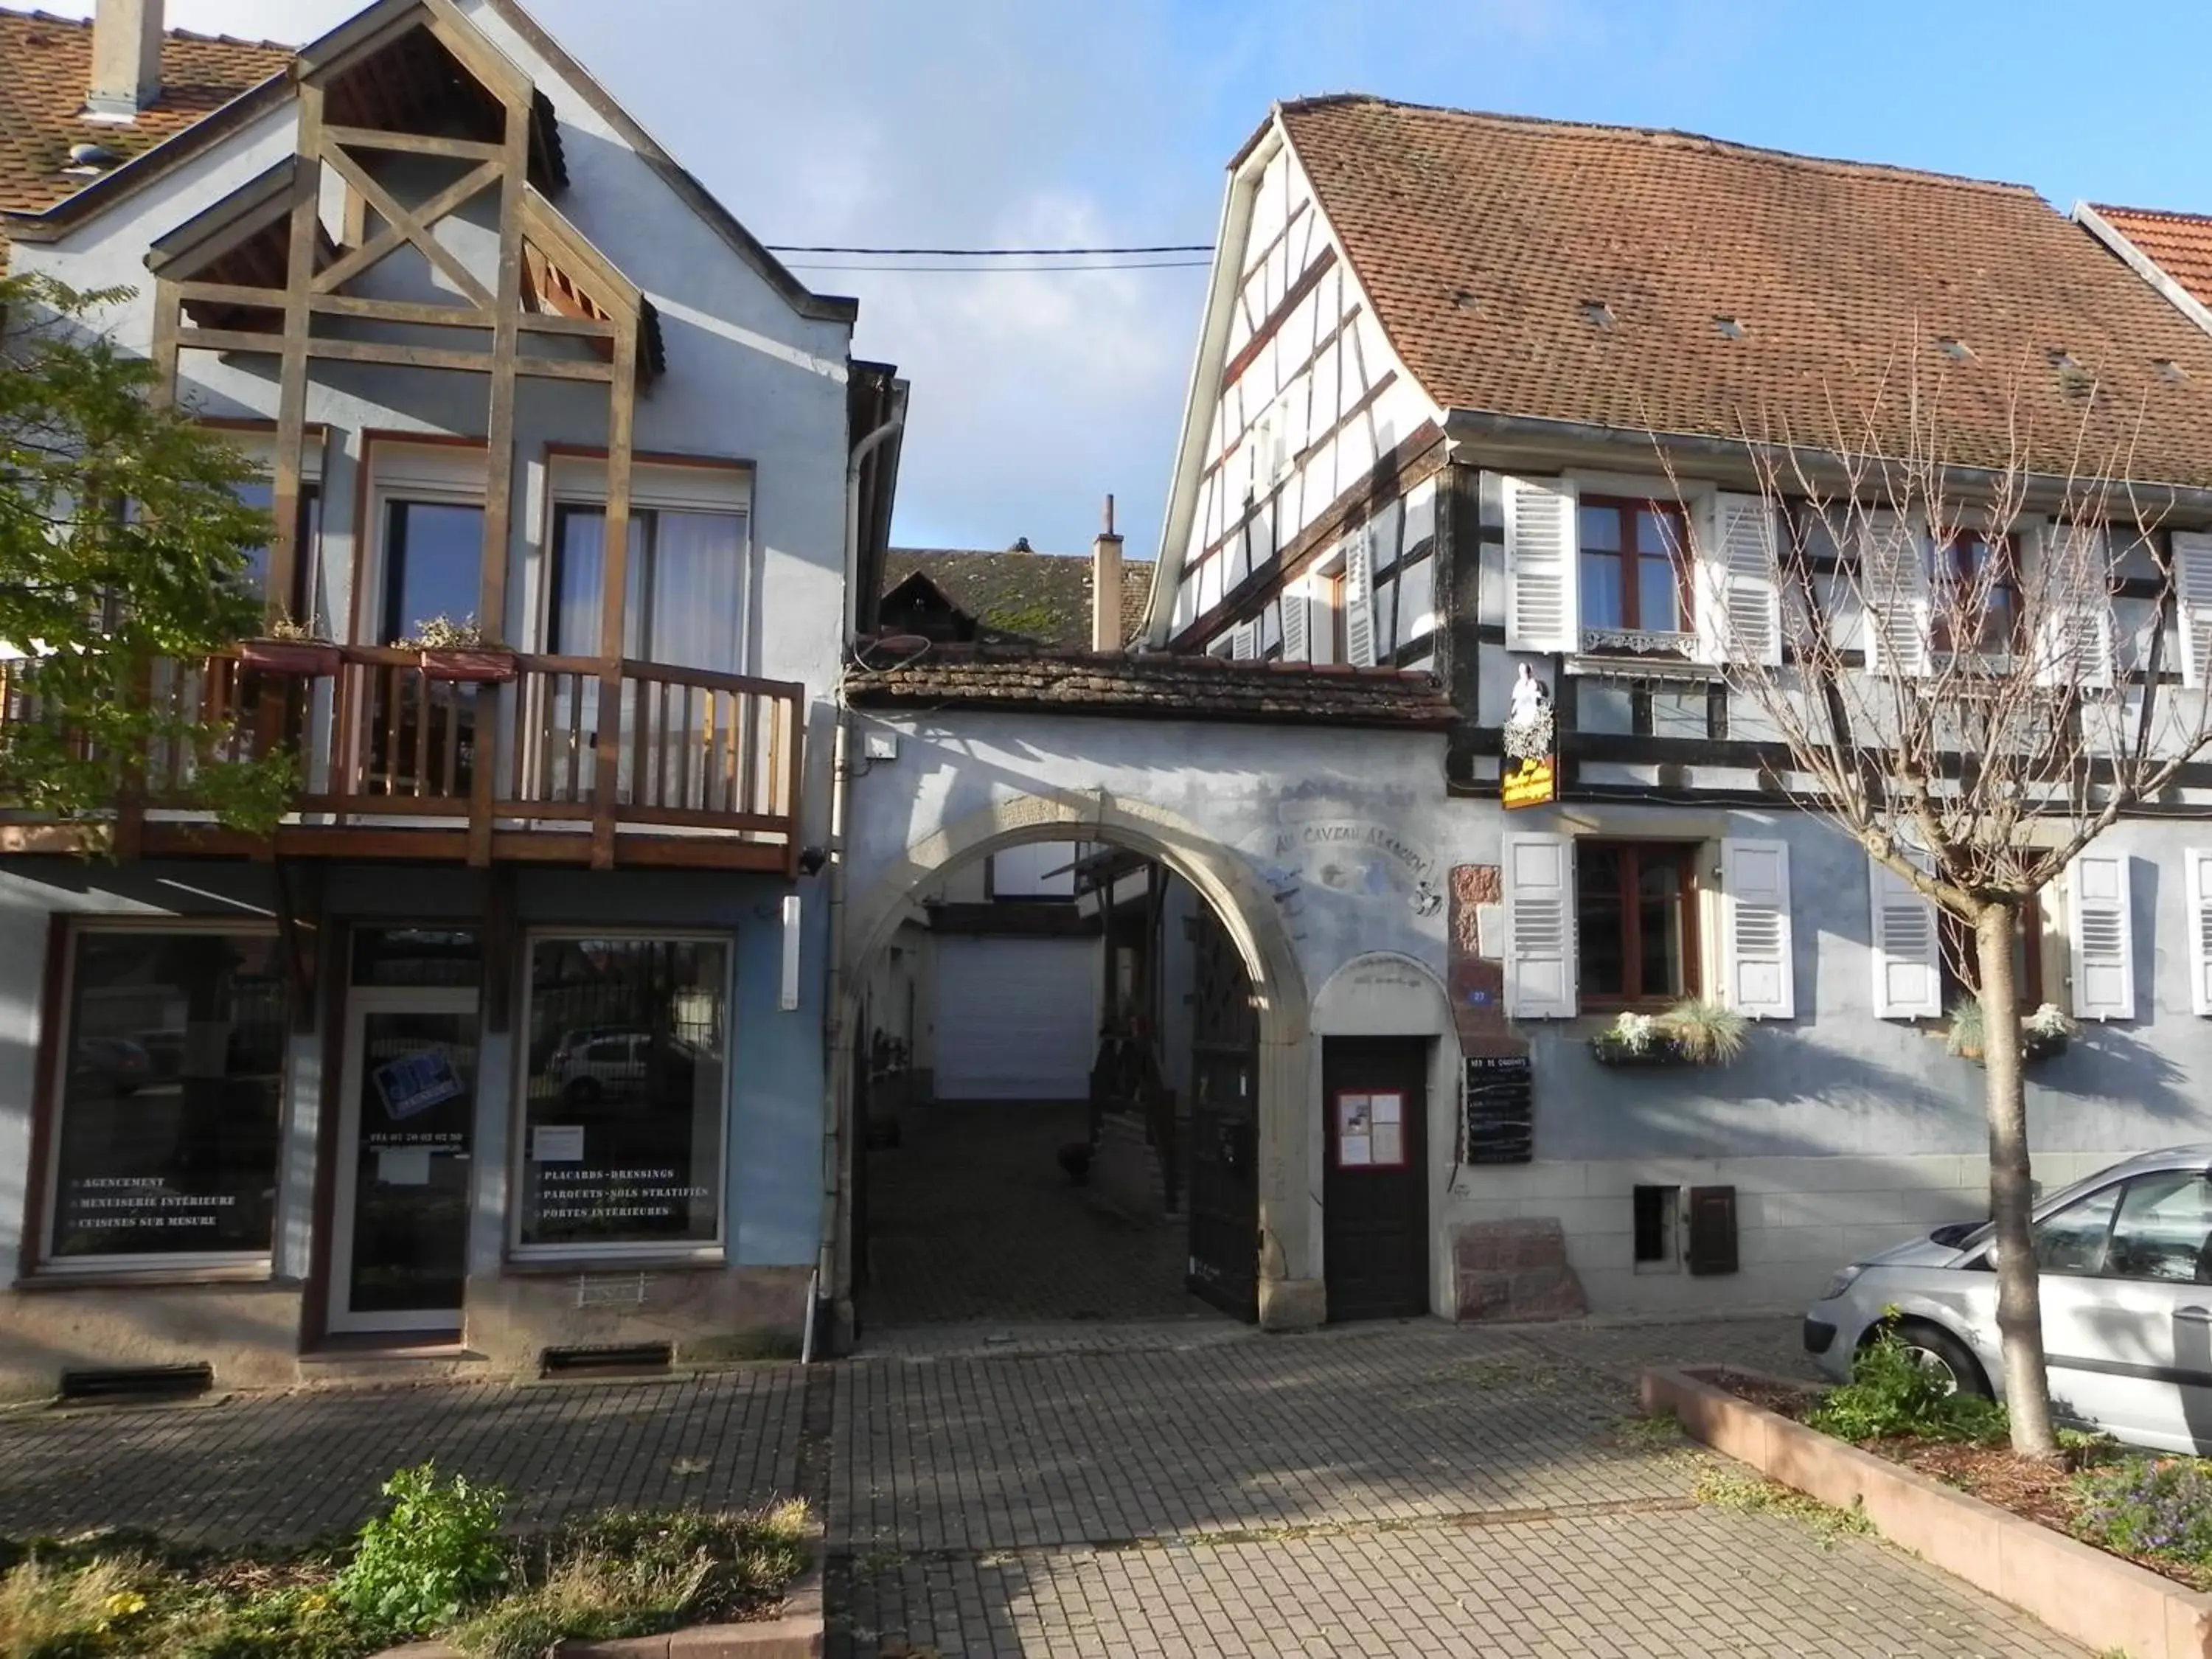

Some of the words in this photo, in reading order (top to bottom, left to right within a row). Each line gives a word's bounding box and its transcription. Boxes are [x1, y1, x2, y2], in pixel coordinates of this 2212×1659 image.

[1304, 826, 1360, 843] CAVEAU
[83, 1178, 165, 1188] AGENCEMENT
[79, 1196, 157, 1208] MENUISERIE
[543, 1208, 588, 1218] PORTES
[78, 1217, 136, 1228] CUISINES
[139, 1216, 164, 1227] SUR
[167, 1215, 217, 1226] MESURE
